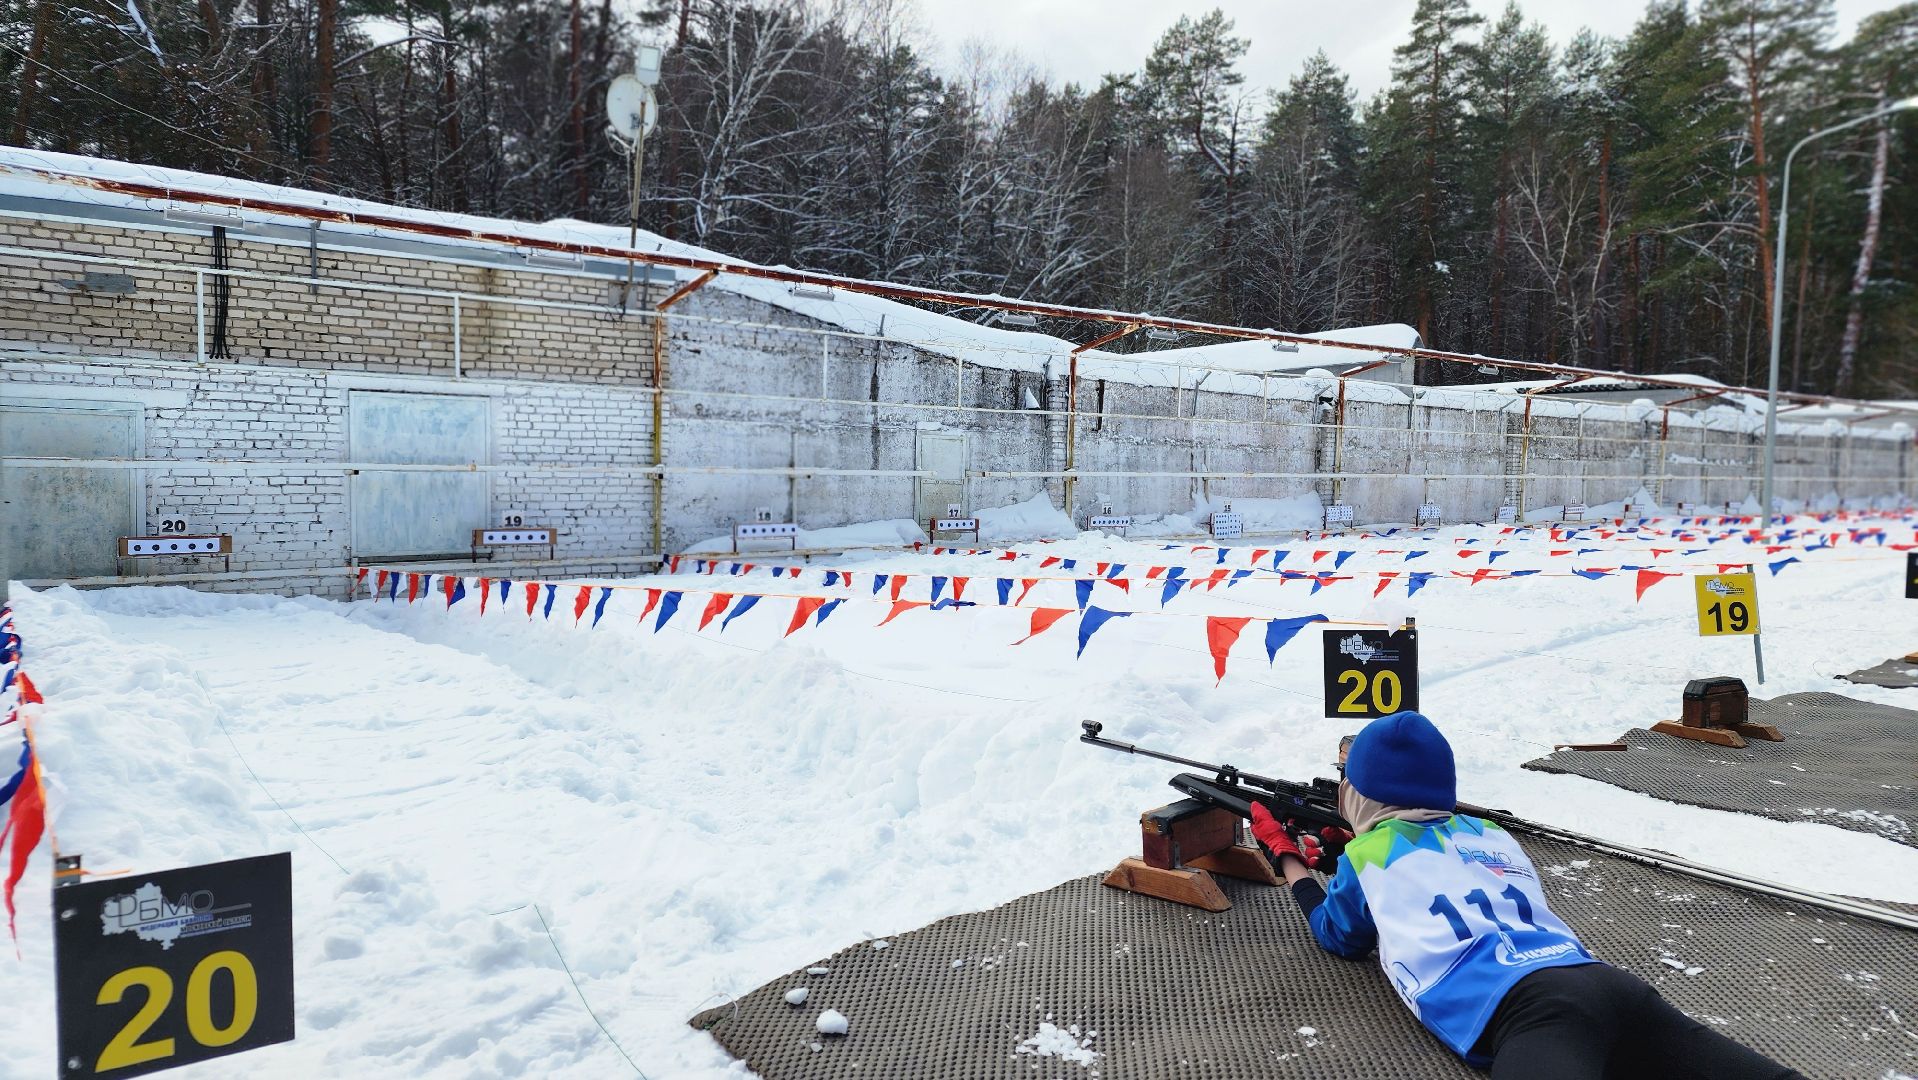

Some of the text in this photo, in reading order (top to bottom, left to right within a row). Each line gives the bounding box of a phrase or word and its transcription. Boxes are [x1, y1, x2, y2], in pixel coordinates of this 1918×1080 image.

[161, 519, 186, 533] 20
[504, 516, 522, 527] 19
[758, 512, 771, 521] 18
[949, 509, 959, 517] 17
[1707, 601, 1749, 632] 19
[1337, 669, 1402, 714] 20
[103, 889, 214, 928] ФБМО
[1428, 883, 1548, 942] 111
[94, 950, 258, 1073] 20
